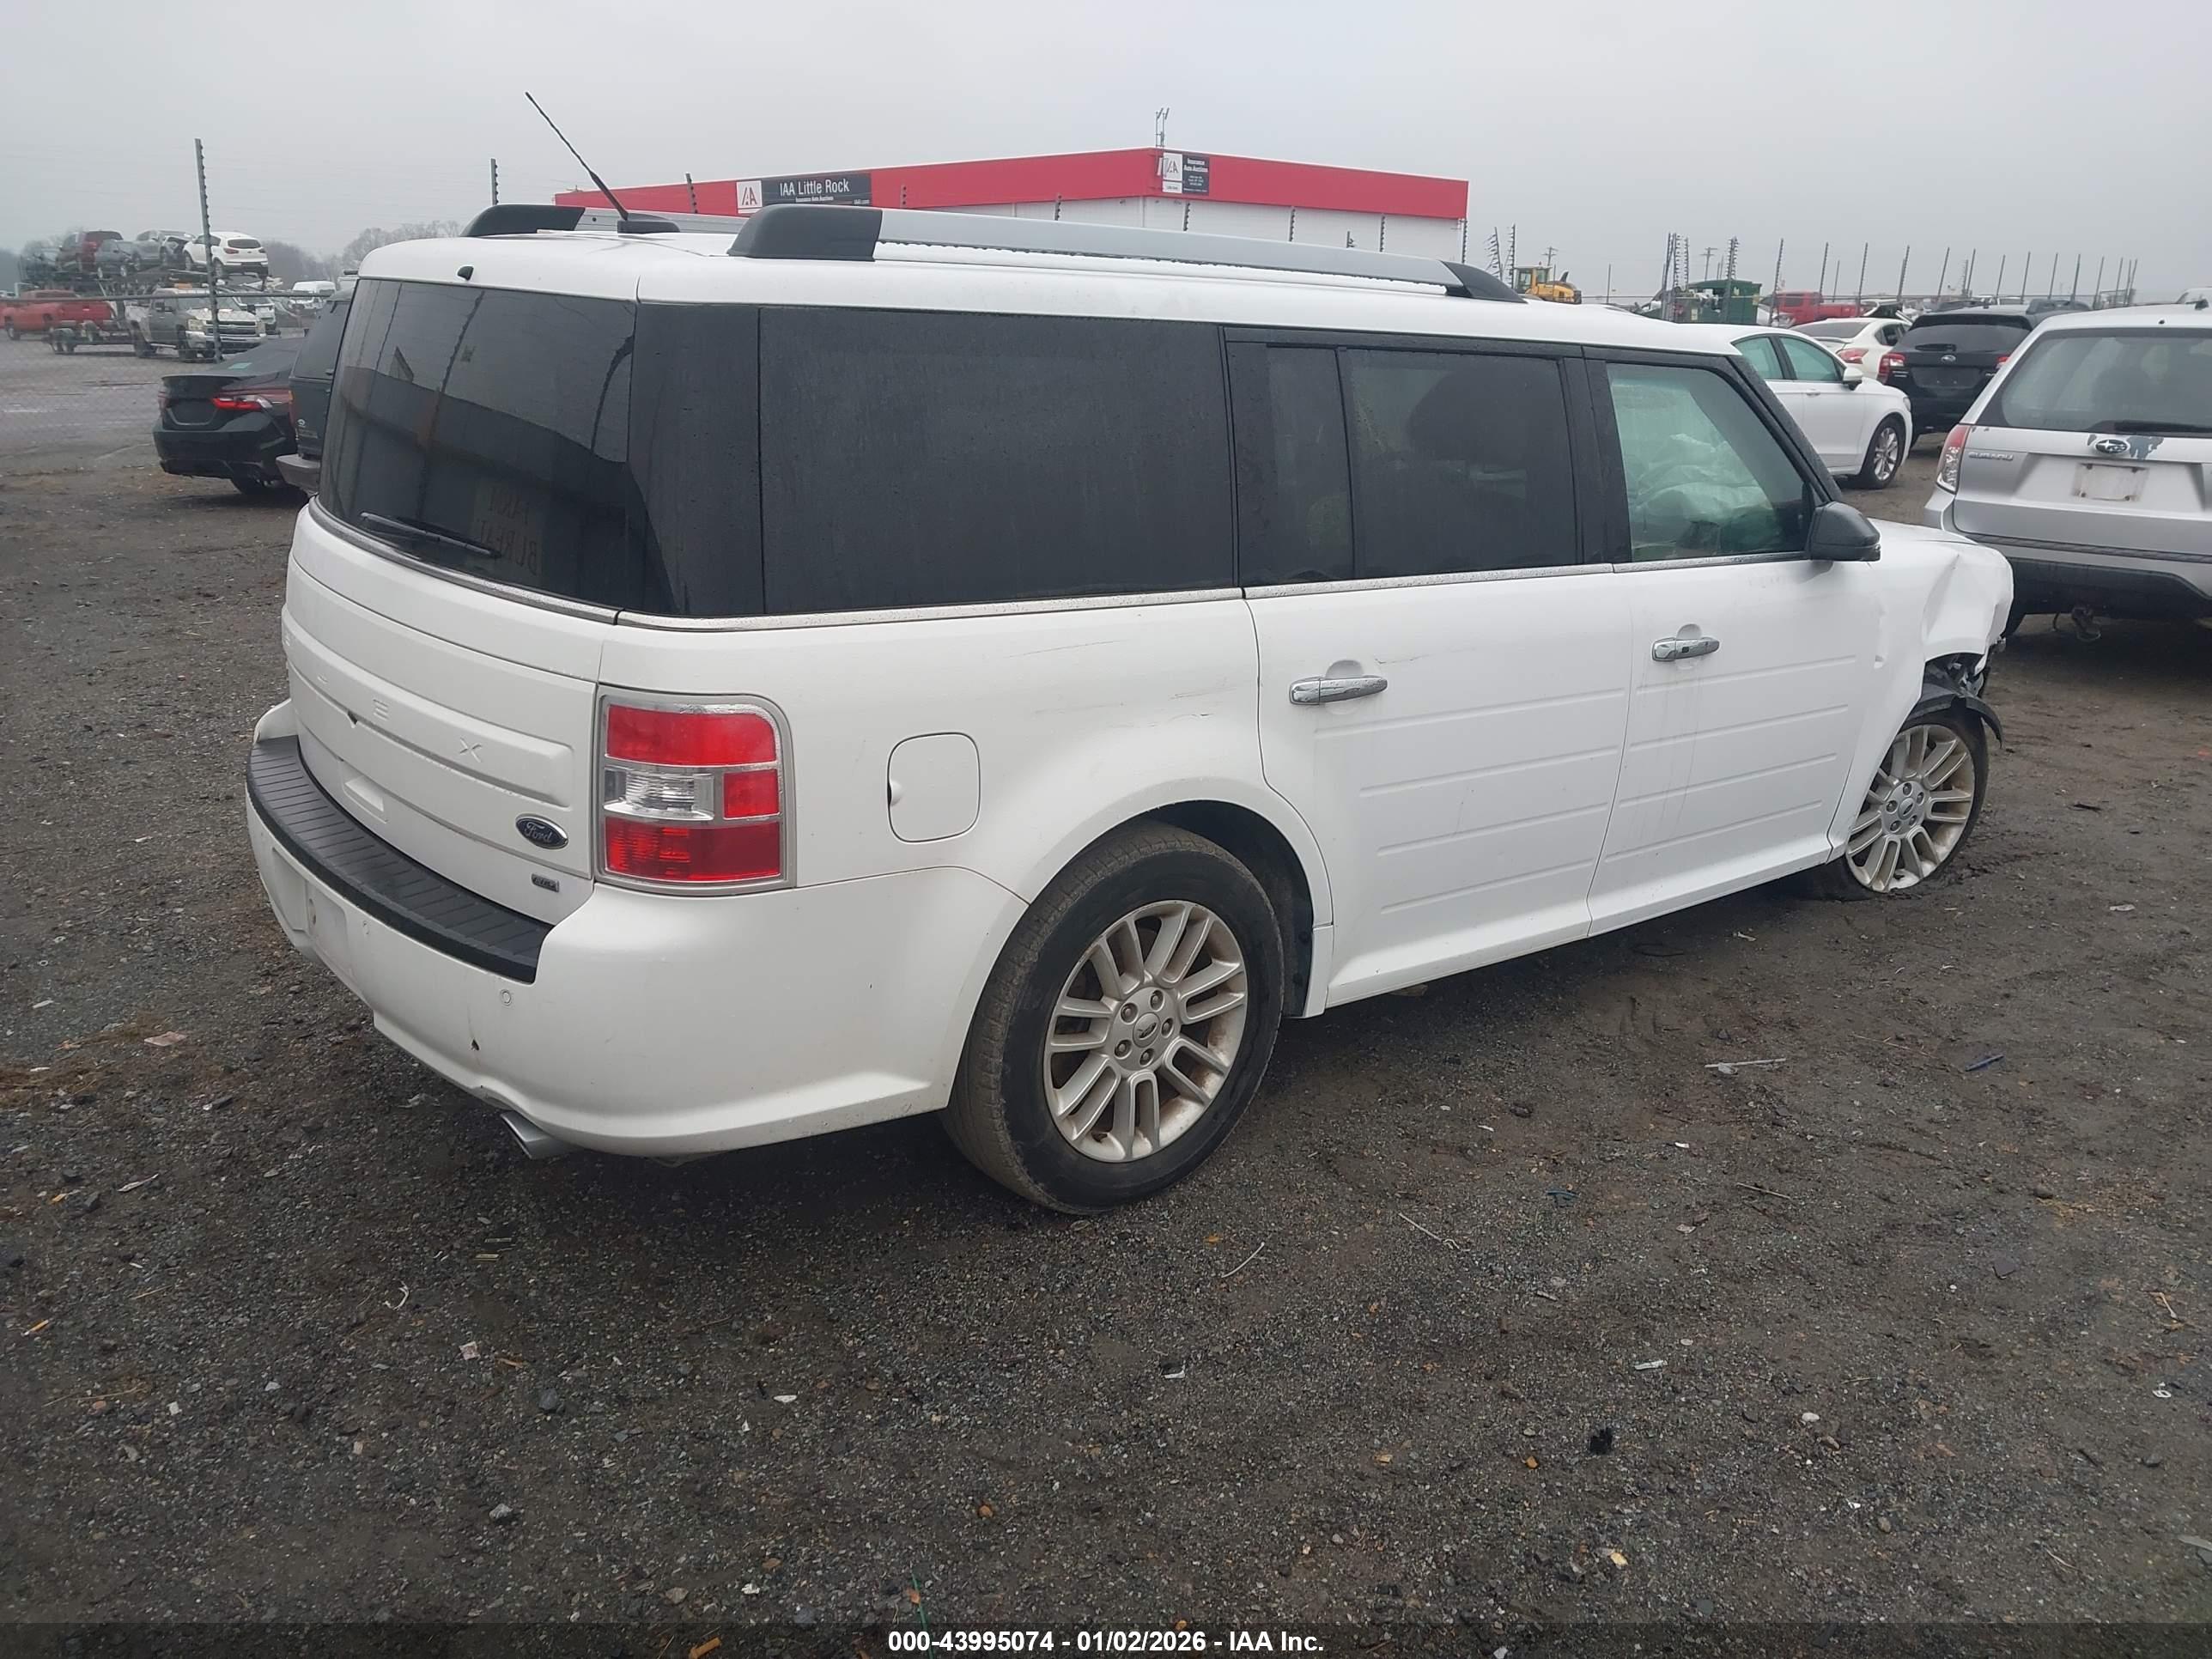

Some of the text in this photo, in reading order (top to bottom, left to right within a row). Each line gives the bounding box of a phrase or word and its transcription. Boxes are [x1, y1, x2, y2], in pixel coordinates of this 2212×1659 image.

[780, 178, 850, 197] IAA Little Rock
[524, 821, 554, 843] Ford
